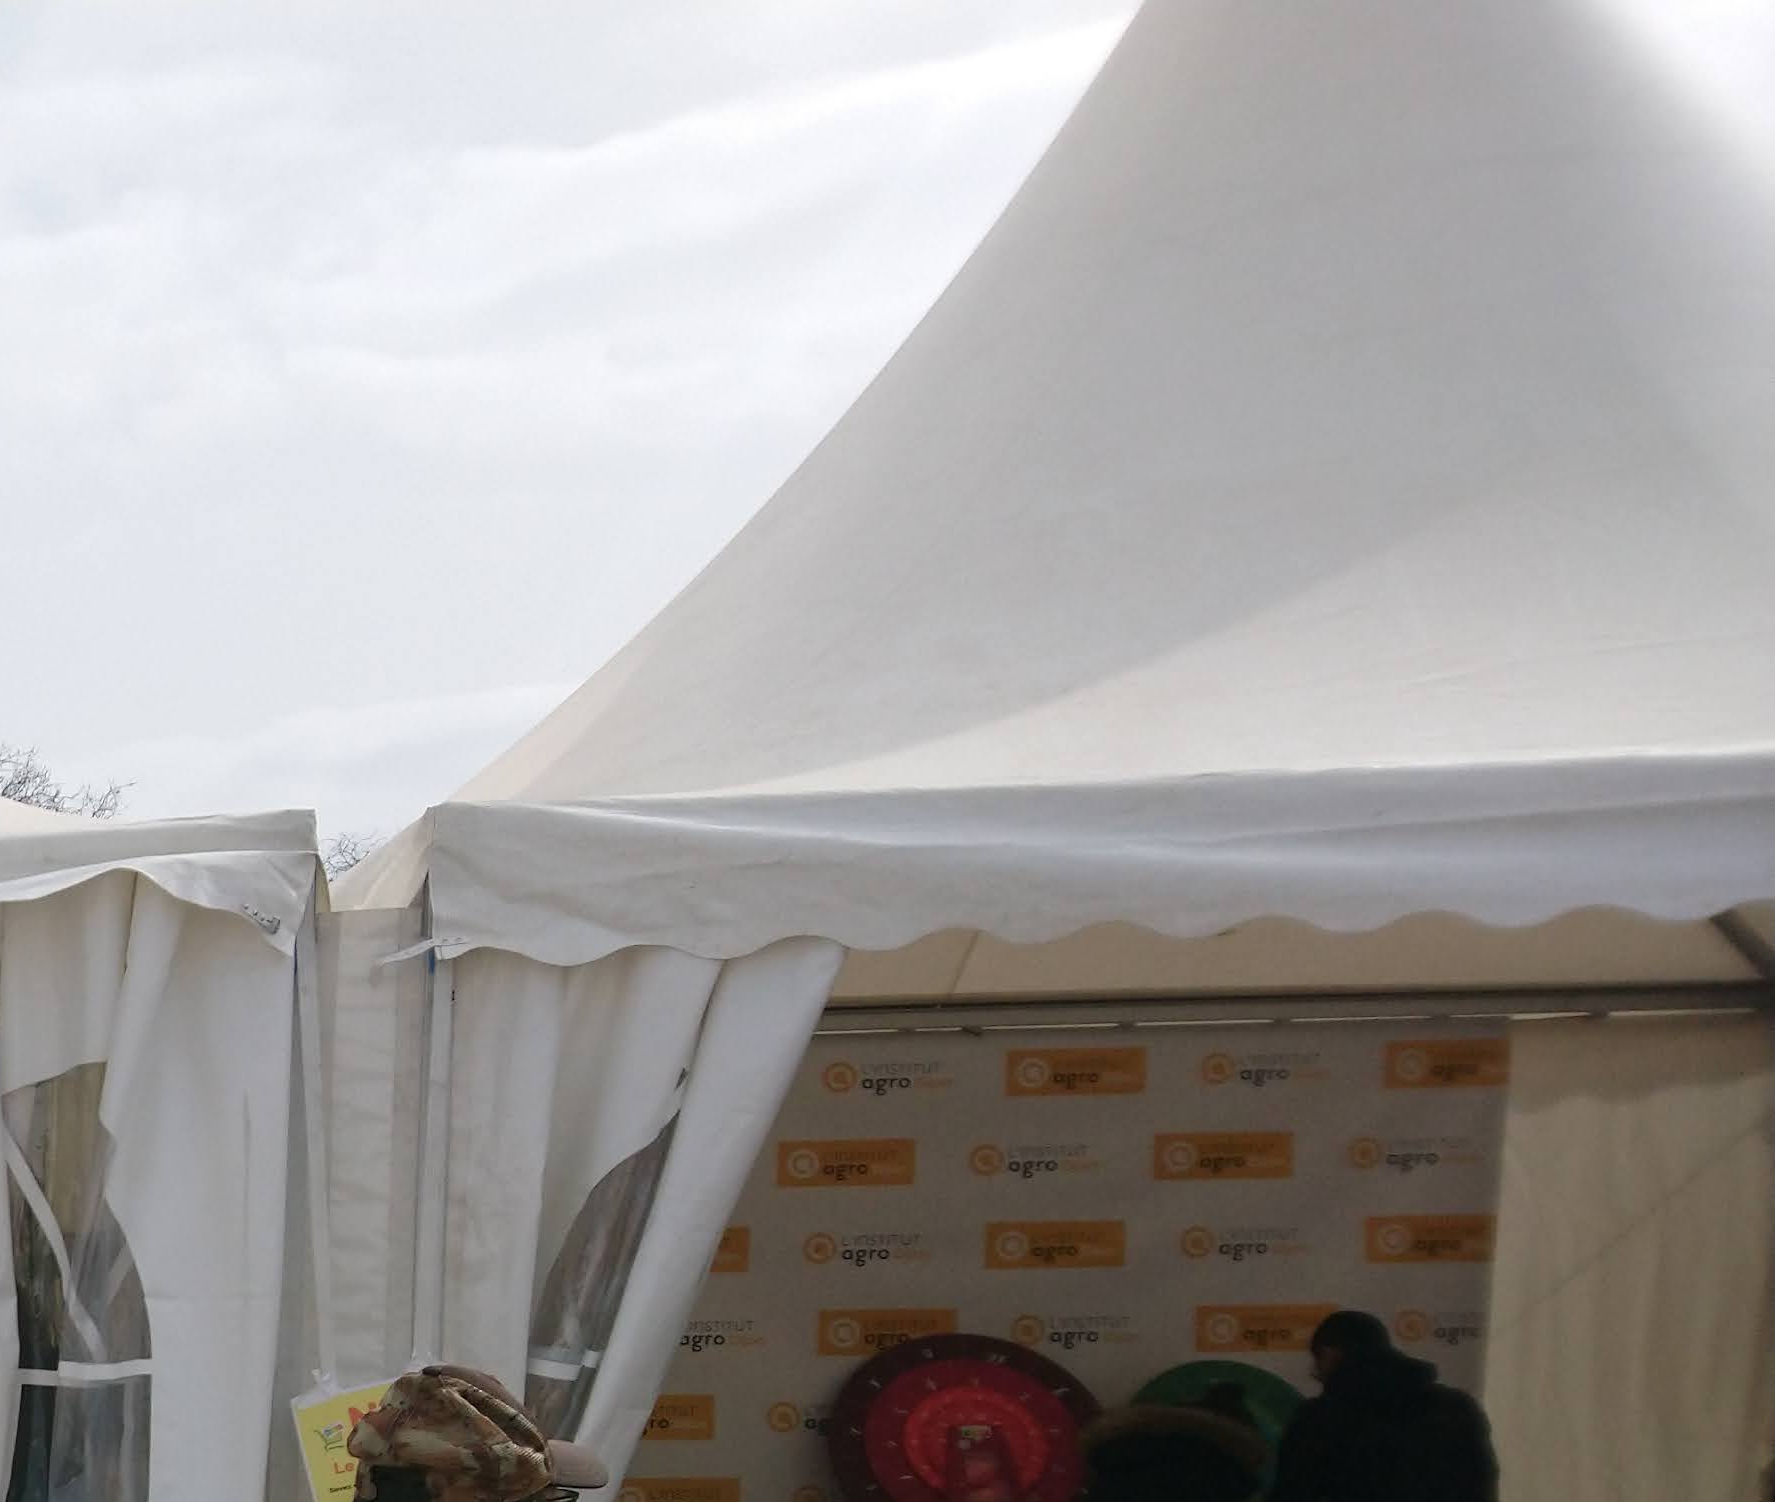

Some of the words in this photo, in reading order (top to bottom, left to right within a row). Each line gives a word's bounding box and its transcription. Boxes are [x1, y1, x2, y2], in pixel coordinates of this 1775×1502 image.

[861, 1076, 912, 1096] agro
[1052, 1071, 1099, 1090] agro
[1239, 1066, 1290, 1087] agro
[823, 1162, 868, 1181] agro
[1008, 1158, 1059, 1178] agro
[1199, 1154, 1247, 1173] agro
[1386, 1152, 1439, 1172] agro
[841, 1247, 891, 1267] agro
[1031, 1243, 1080, 1262] agro
[1218, 1240, 1268, 1261] agro
[680, 1332, 726, 1353] agro
[1050, 1328, 1099, 1349] agro
